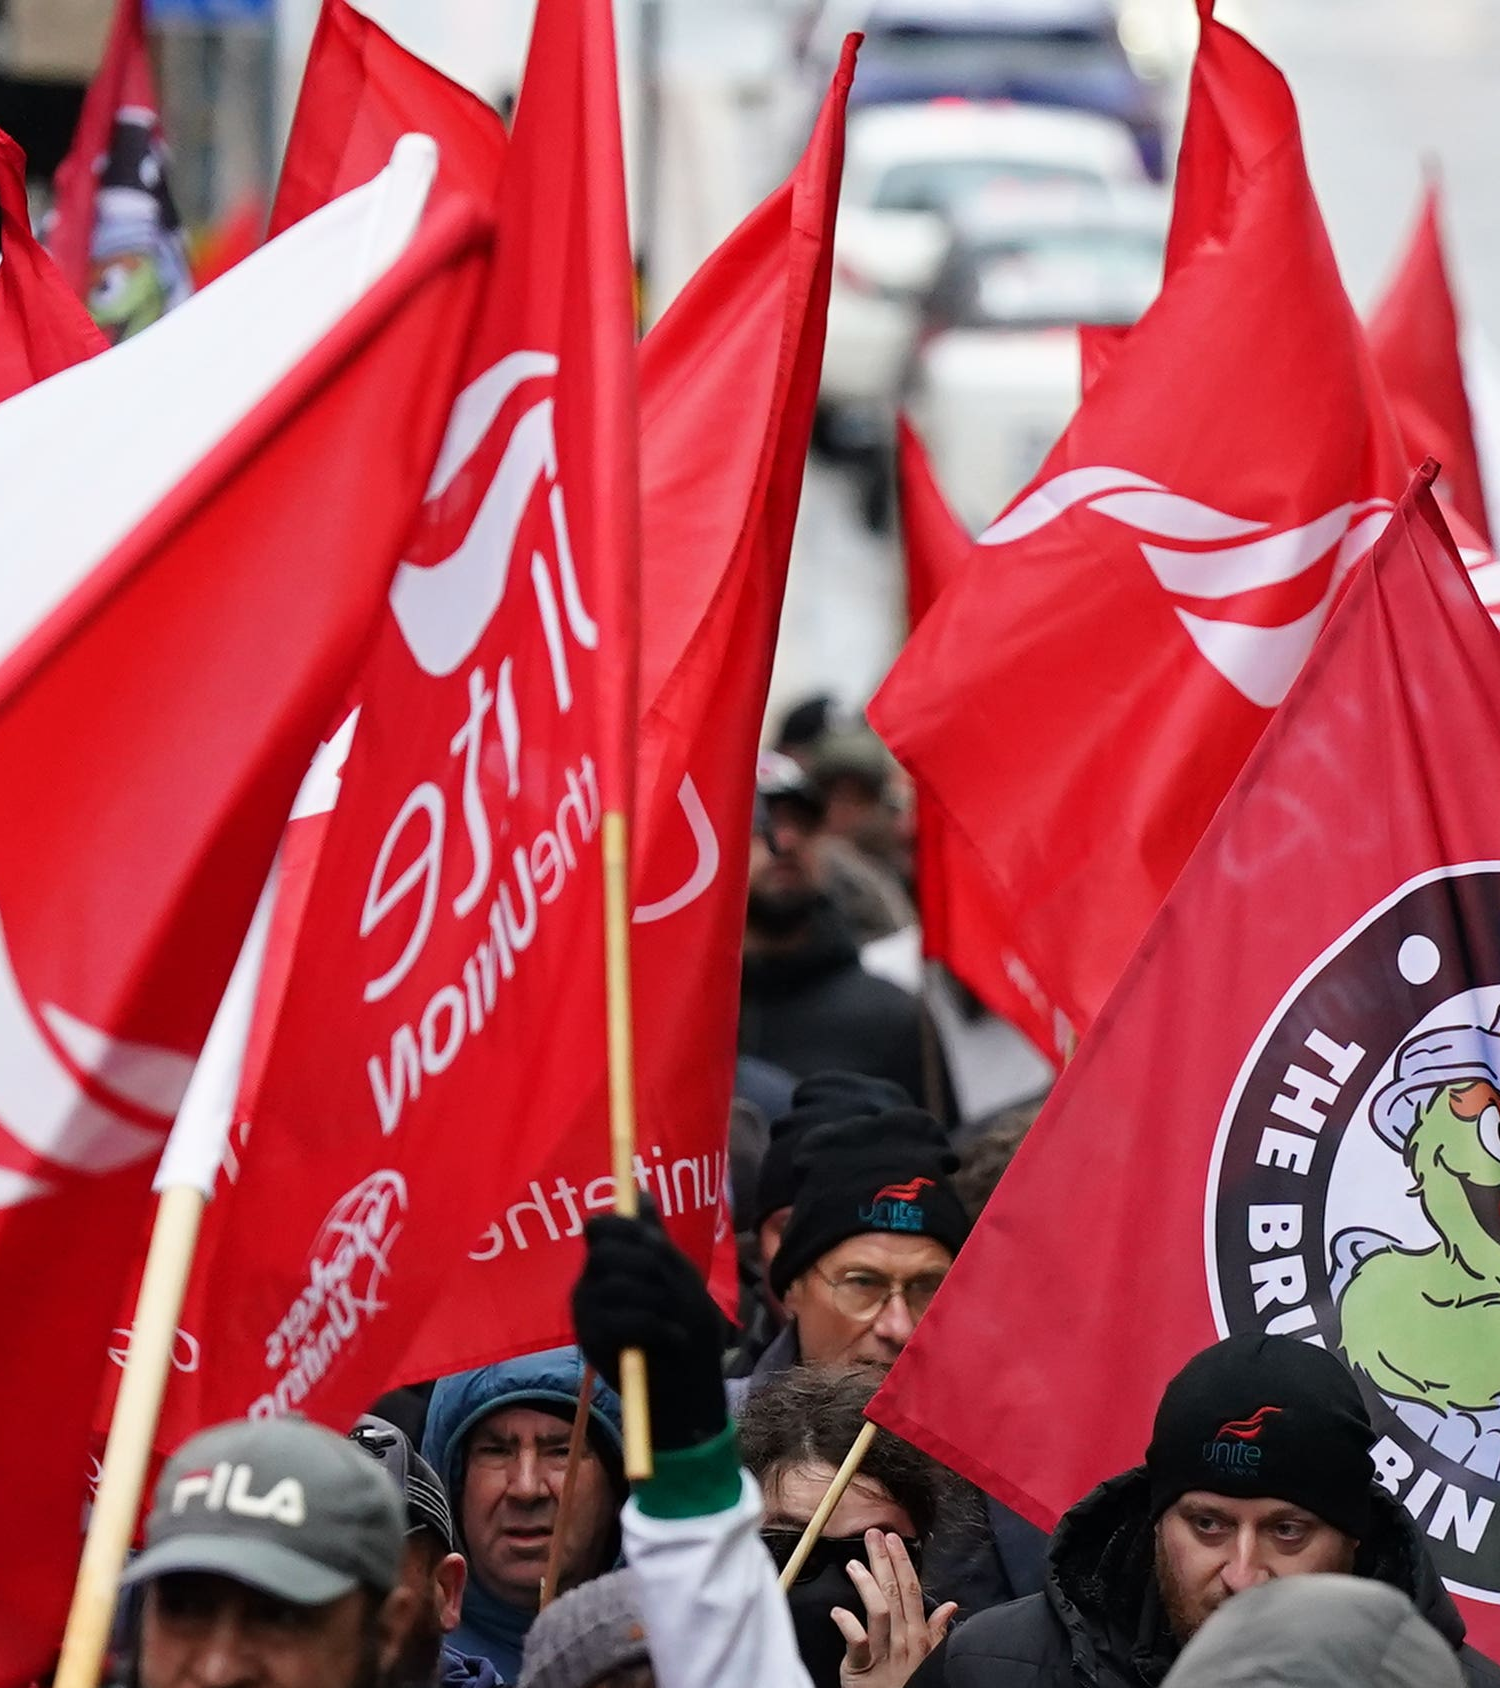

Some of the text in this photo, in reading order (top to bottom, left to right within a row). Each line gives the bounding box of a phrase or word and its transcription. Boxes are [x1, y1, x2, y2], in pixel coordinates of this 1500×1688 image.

[1255, 1028, 1367, 1176] THE
[1248, 1203, 1330, 1349] BRU
[171, 1461, 306, 1527] FILA
[1367, 1434, 1496, 1555] BIN
